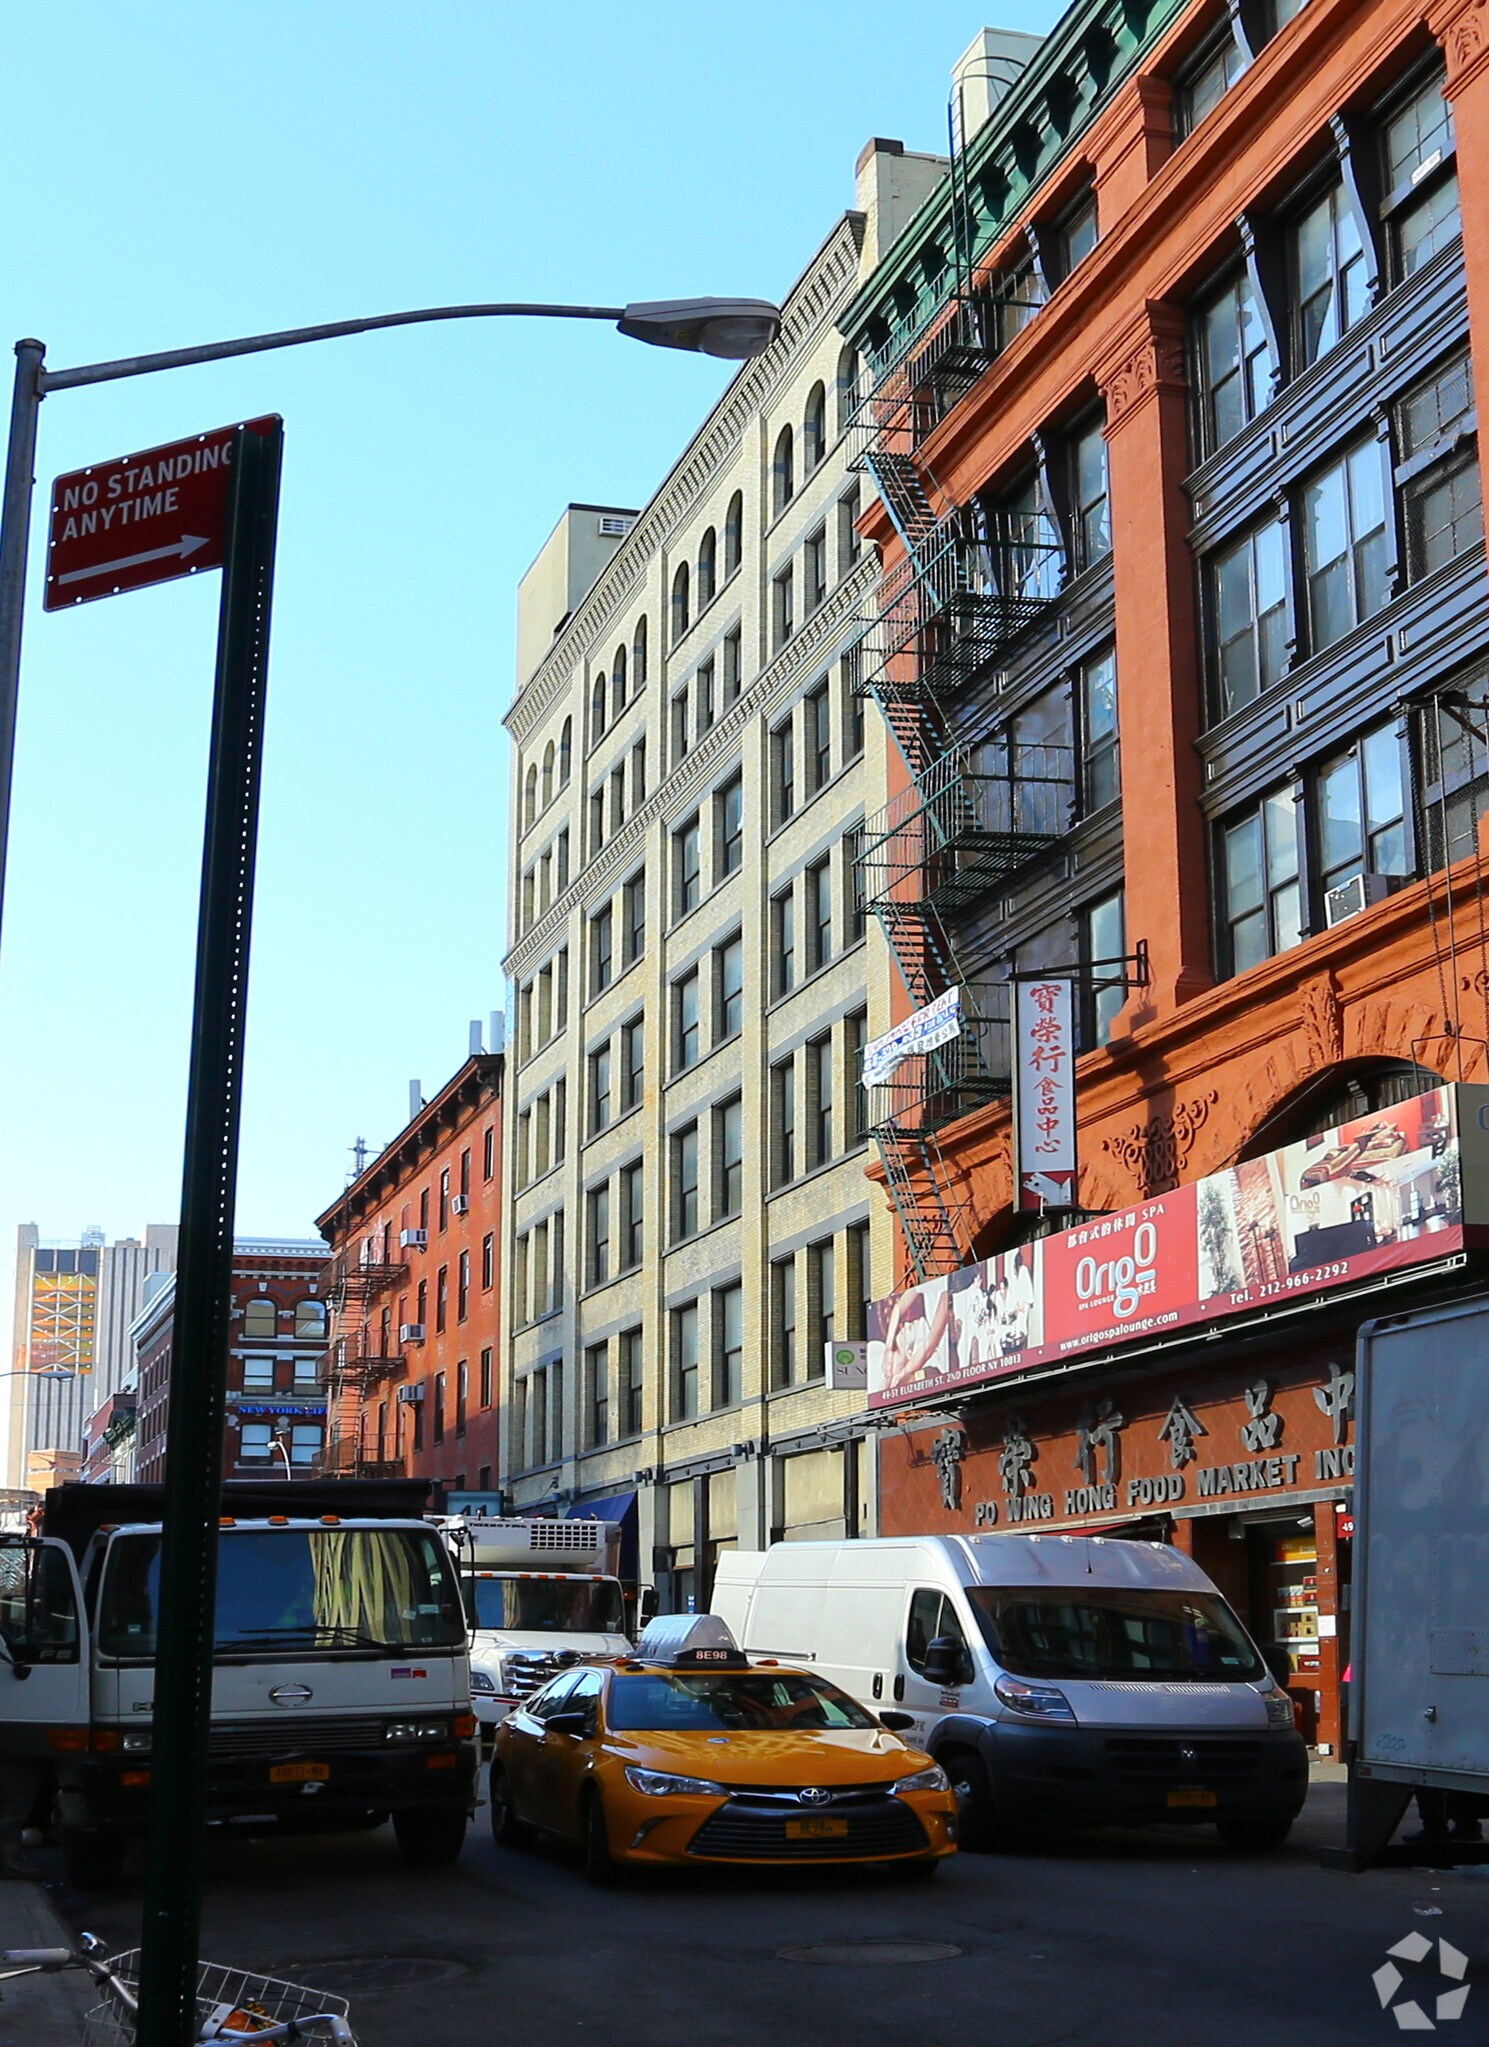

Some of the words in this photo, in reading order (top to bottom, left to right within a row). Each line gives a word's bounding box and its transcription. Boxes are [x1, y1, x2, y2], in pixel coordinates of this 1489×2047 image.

[63, 481, 98, 511] NO
[61, 487, 180, 541] ANYTIME
[1141, 1203, 1165, 1221] SPA
[1230, 1288, 1254, 1305] Tel.
[1259, 1261, 1349, 1298] 212-966-2292
[1078, 1302, 1089, 1312] SPA
[1090, 1293, 1115, 1308] LOUNGE
[1060, 1311, 1178, 1351] www.origospalounge.com
[900, 1379, 934, 1396] ELIZABETH
[934, 1376, 945, 1388] ST.
[946, 1371, 962, 1384] 2ND
[963, 1365, 986, 1378] FLOOR
[987, 1360, 998, 1371] NY
[999, 1353, 1022, 1368] 10013
[239, 1406, 266, 1415] NEW
[268, 1406, 302, 1415] YORK
[975, 1502, 997, 1526] PO
[1005, 1494, 1053, 1522] WING
[1064, 1484, 1116, 1515] HONG
[1127, 1473, 1184, 1506] FOOD
[1196, 1455, 1299, 1496] MARKET
[1342, 1521, 1354, 1532] 49
[695, 1650, 728, 1660] 8E98
